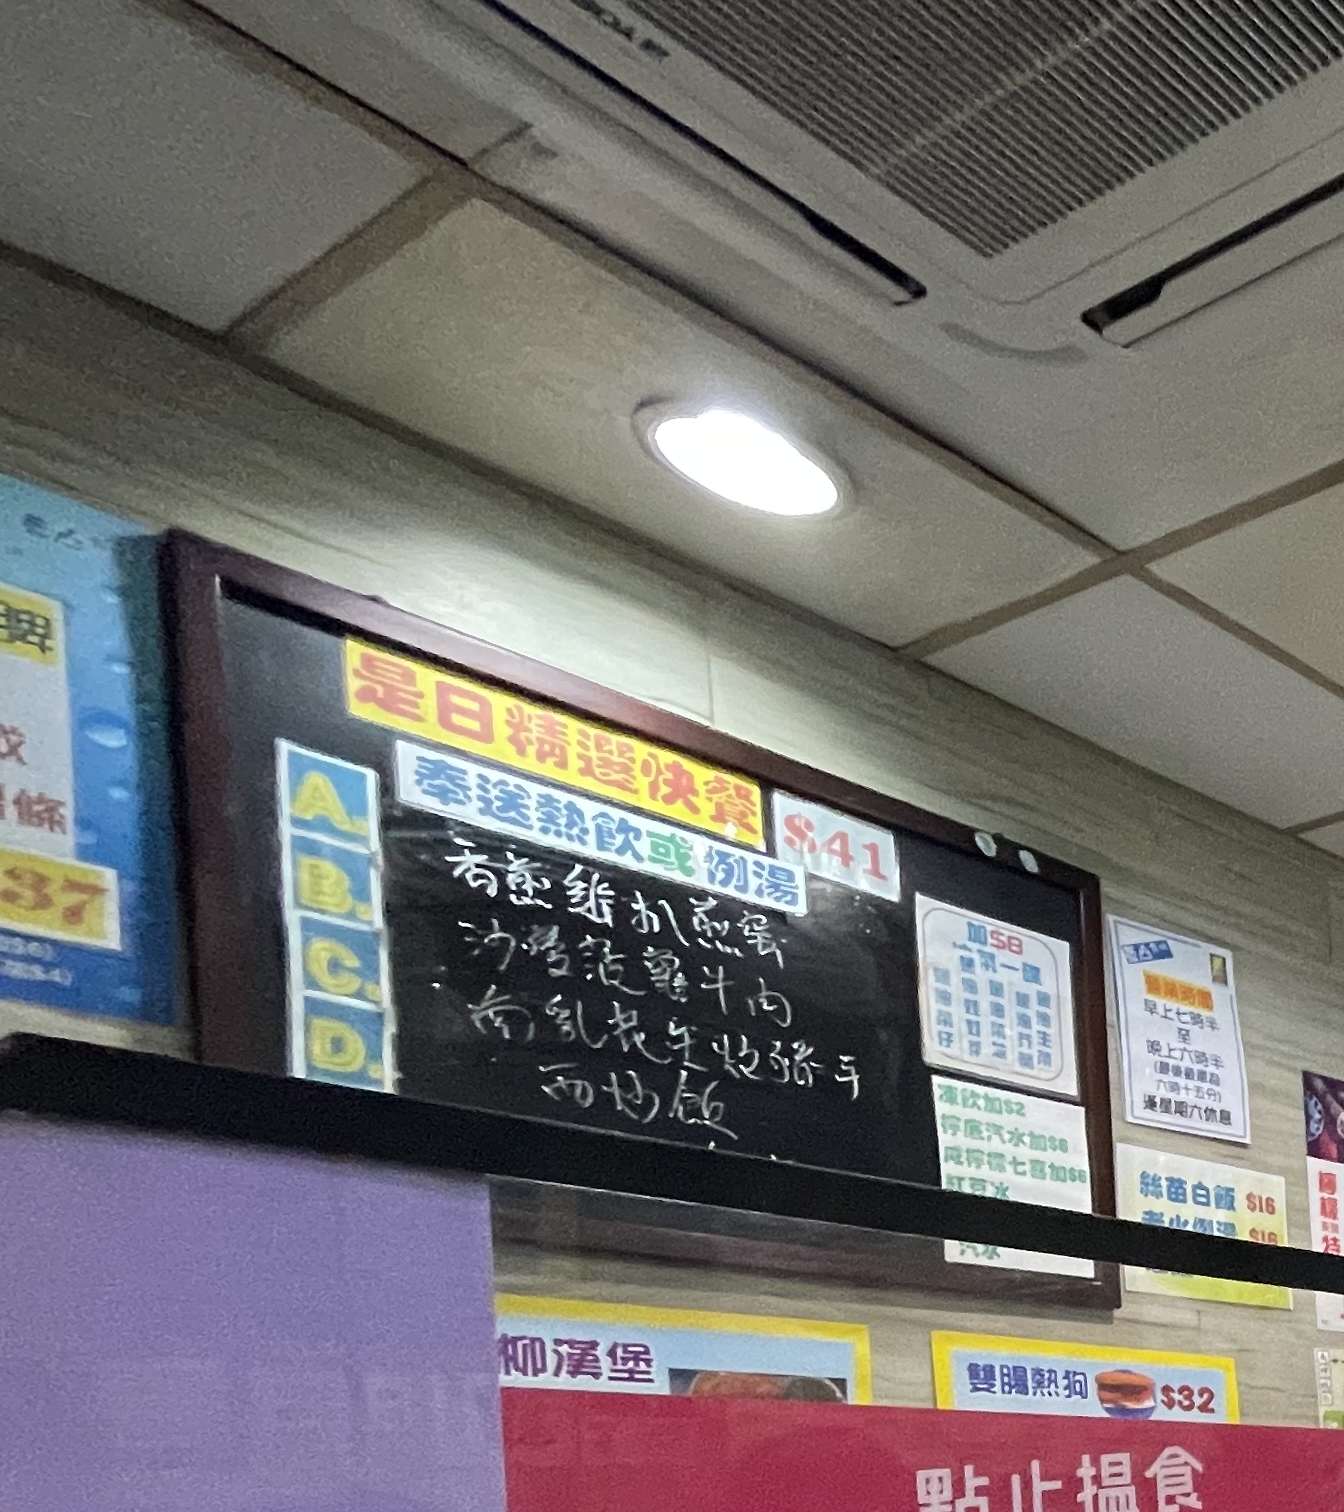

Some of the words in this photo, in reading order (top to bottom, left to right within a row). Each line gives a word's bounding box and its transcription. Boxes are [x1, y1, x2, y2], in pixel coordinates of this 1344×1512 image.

[352, 652, 758, 836] 是日精選快餐
[415, 755, 800, 907] 奉送熱飲或例湯
[783, 811, 887, 884] $41
[1144, 999, 1220, 1032] 早上七時半
[1177, 1027, 1191, 1045] 至
[1146, 1039, 1225, 1070] 晚上六時半
[1139, 1170, 1236, 1212] 絲苗白飯
[1246, 1191, 1276, 1215] $16
[966, 1361, 1089, 1401] 雙腸熱狗
[1160, 1383, 1216, 1415] $32
